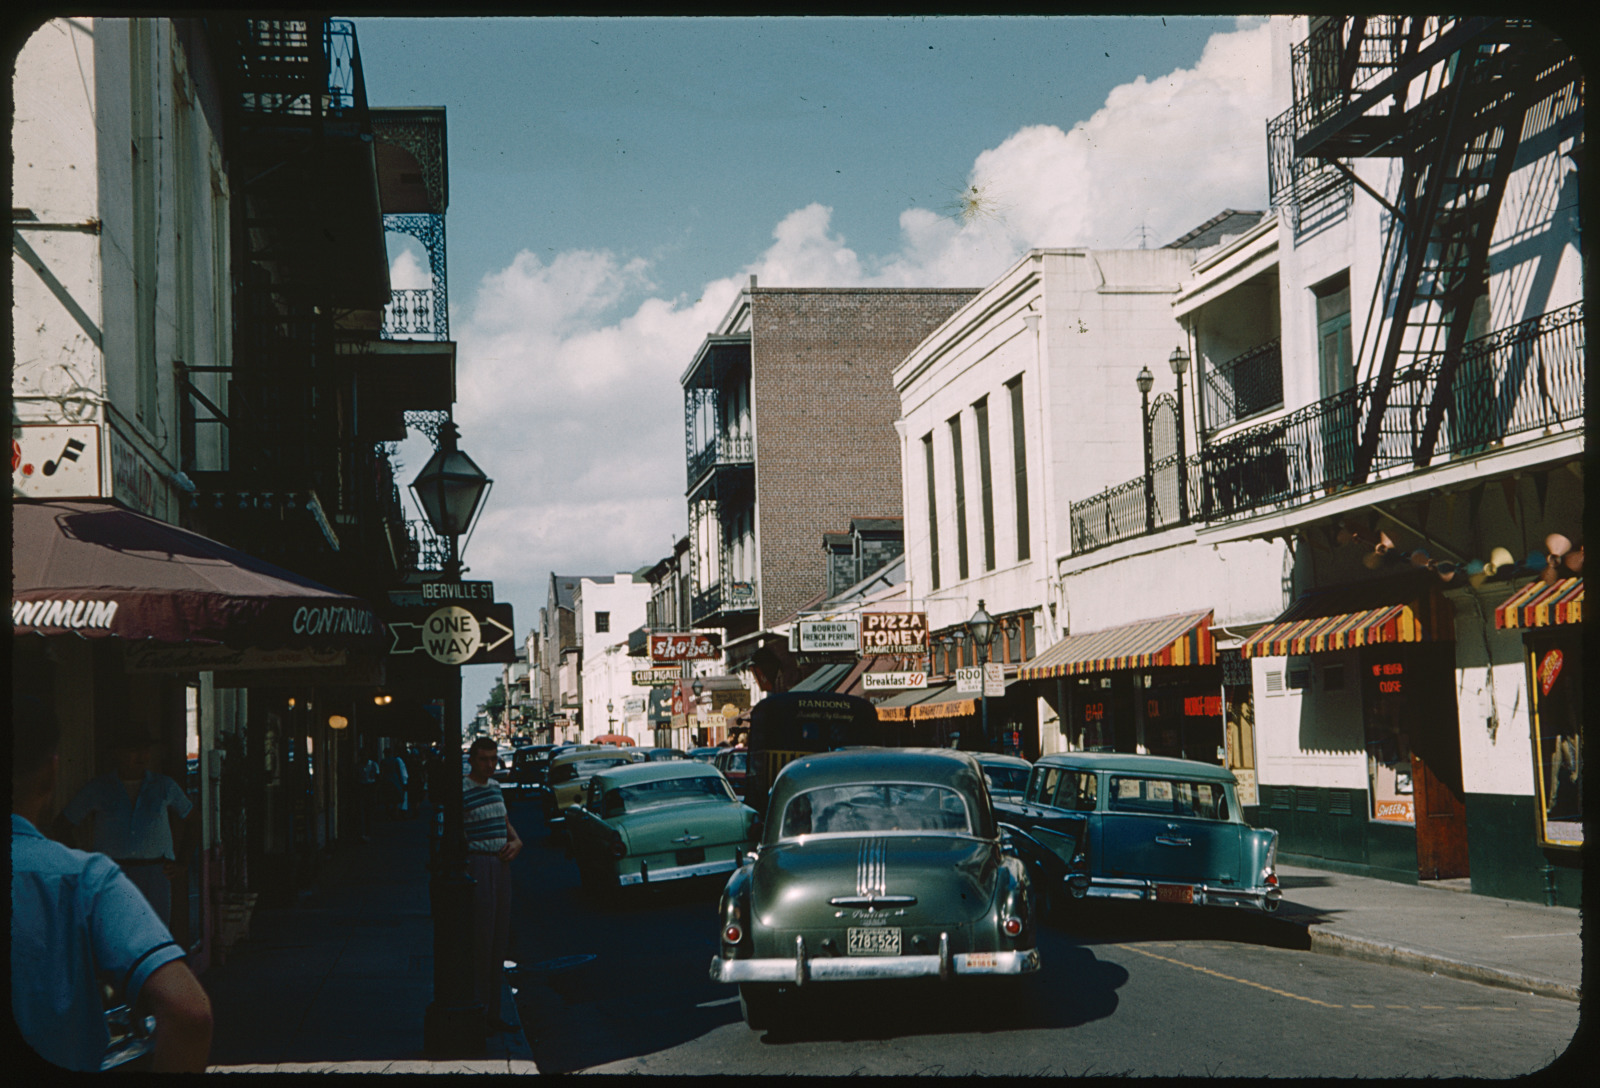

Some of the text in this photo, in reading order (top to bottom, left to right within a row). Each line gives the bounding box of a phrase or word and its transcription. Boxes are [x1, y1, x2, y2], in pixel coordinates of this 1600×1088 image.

[423, 584, 493, 599] IBERVILLE ST
[429, 616, 472, 634] ONE
[812, 624, 847, 632] BOURBON
[868, 614, 921, 629] PIZZA
[803, 633, 855, 641] FRENCH PERFUME
[863, 629, 925, 646] TONEY
[429, 638, 474, 656] WAY
[865, 645, 924, 654] SPAGHETTI HOUSE
[635, 670, 681, 681] CLUB PIGALLE
[866, 673, 924, 686] Breakfast 50
[958, 670, 980, 680] ROO
[1085, 702, 1104, 722] BAR
[850, 935, 899, 949] 278 522
